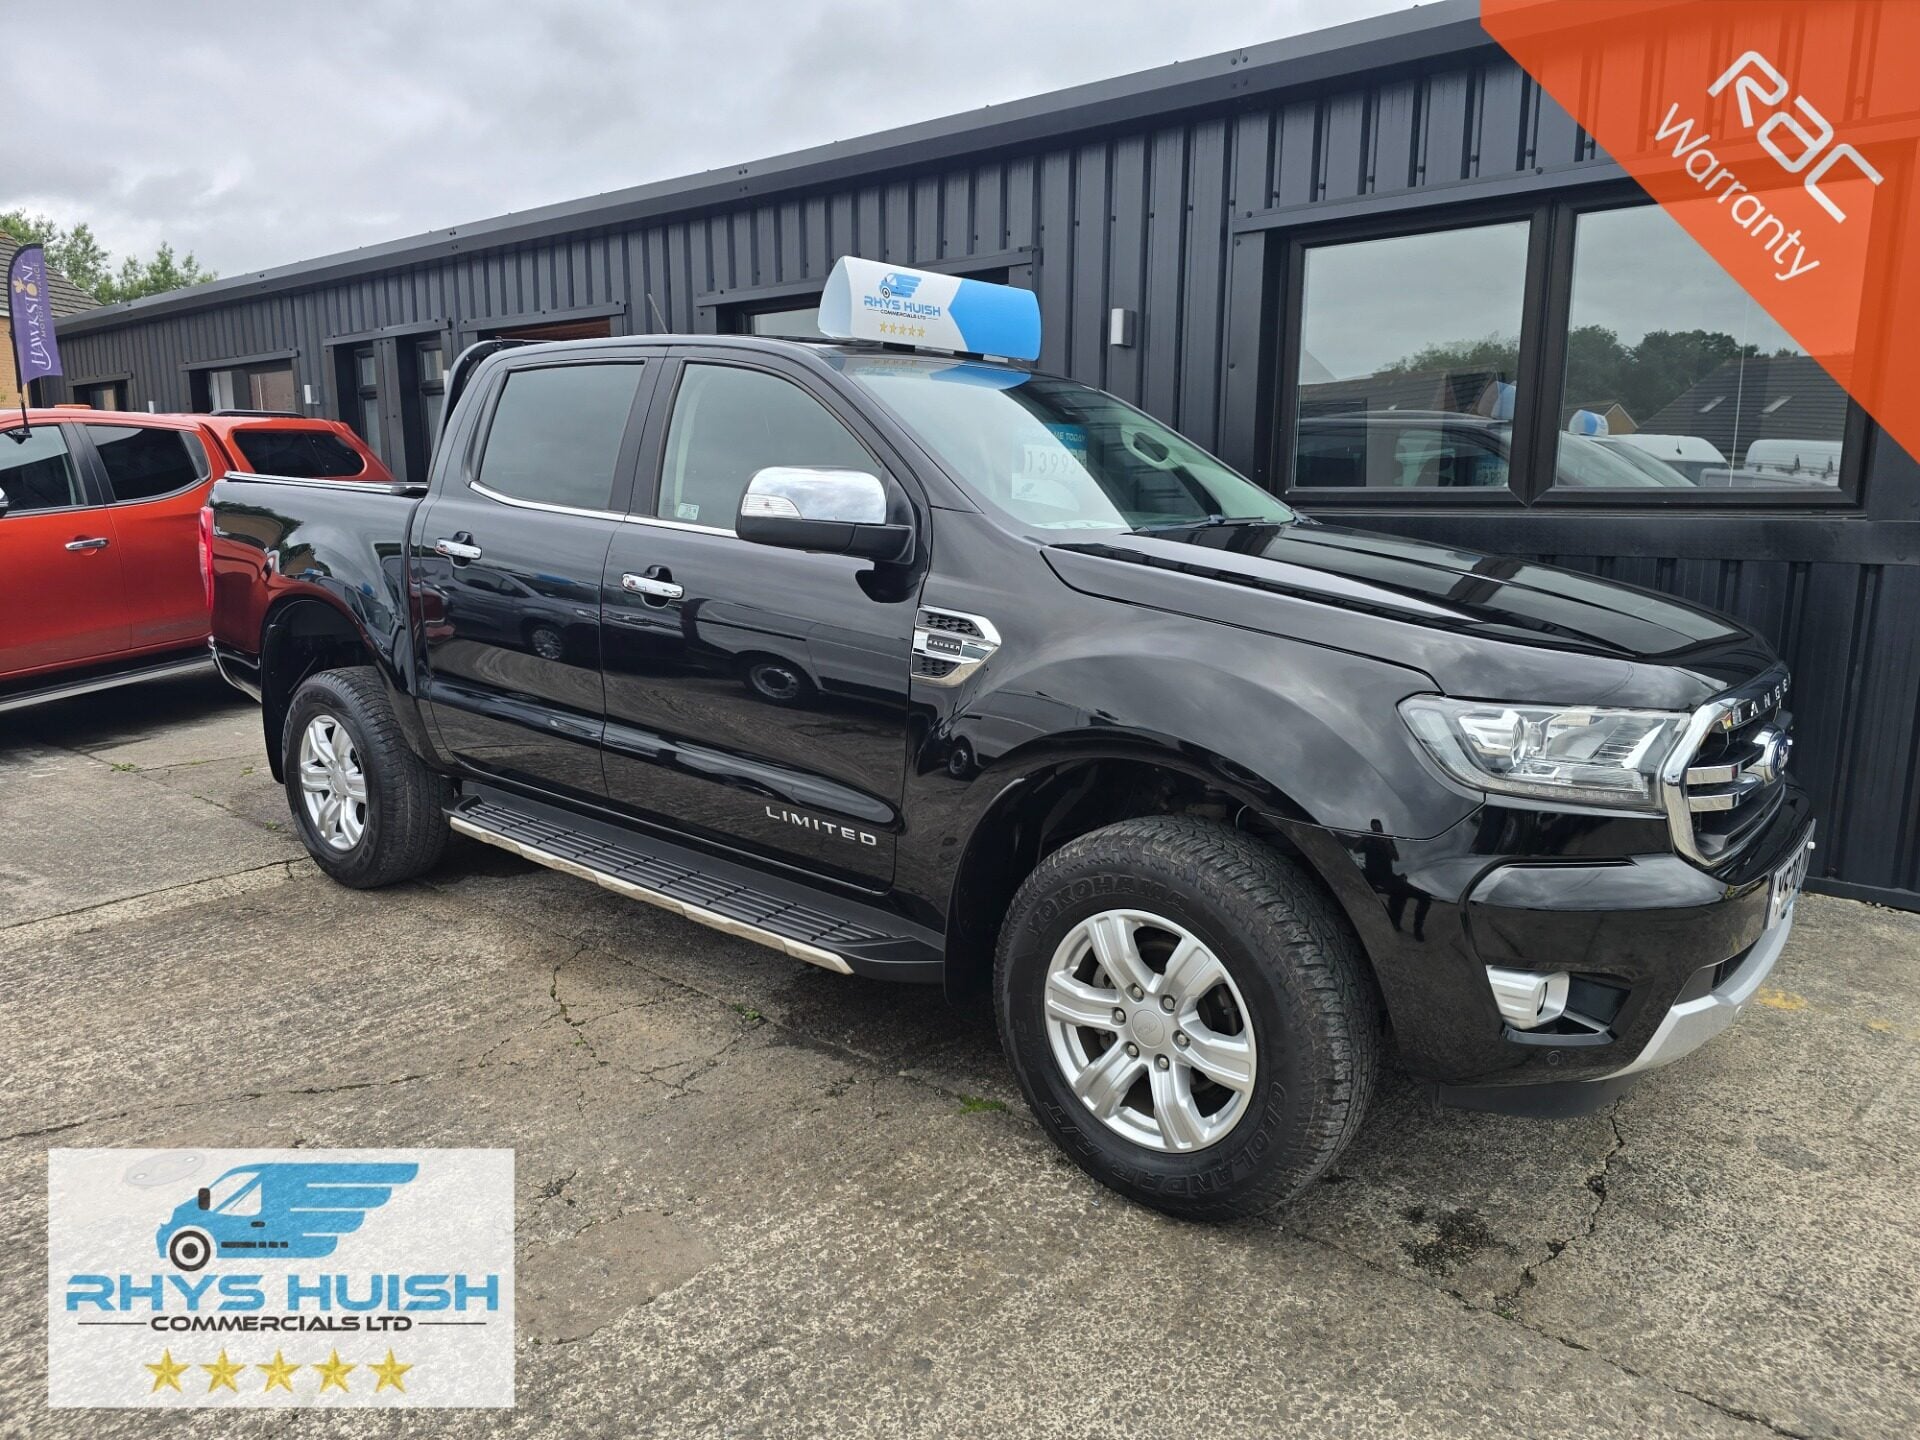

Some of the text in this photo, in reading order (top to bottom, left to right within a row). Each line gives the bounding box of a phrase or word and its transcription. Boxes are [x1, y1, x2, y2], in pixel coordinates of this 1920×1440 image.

[864, 295, 941, 317] RHYS HUISH
[927, 640, 960, 651] RANGER
[765, 806, 877, 846] LIMITED
[1028, 871, 1189, 937] YOKOHAMA
